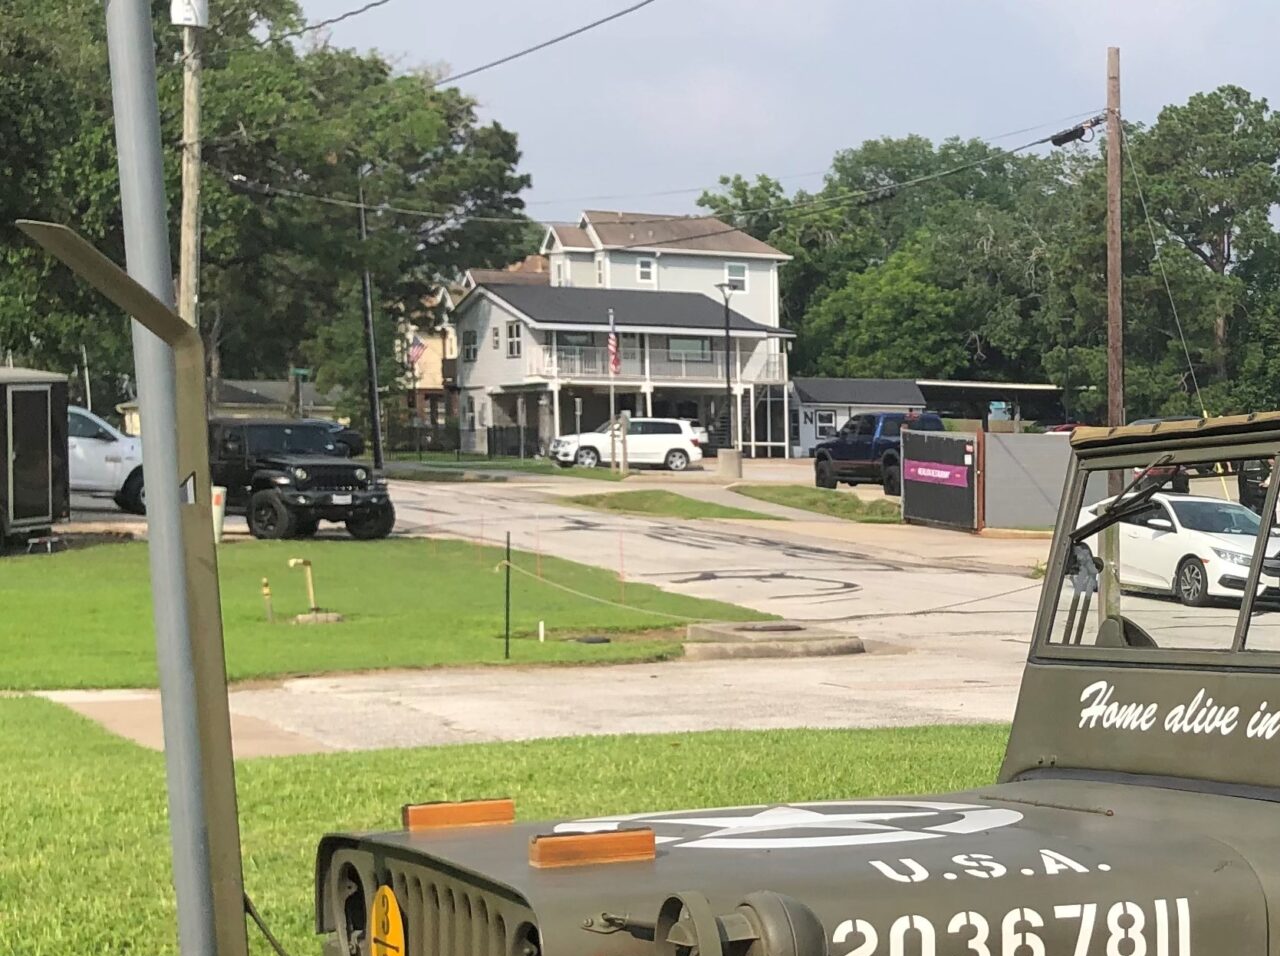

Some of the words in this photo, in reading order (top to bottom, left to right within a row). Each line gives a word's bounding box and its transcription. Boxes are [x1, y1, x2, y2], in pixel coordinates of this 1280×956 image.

[803, 411, 814, 424] N
[1078, 680, 1158, 731] Home
[1164, 688, 1240, 735] alive
[868, 848, 1112, 883] U.S.A.
[382, 894, 390, 935] 3
